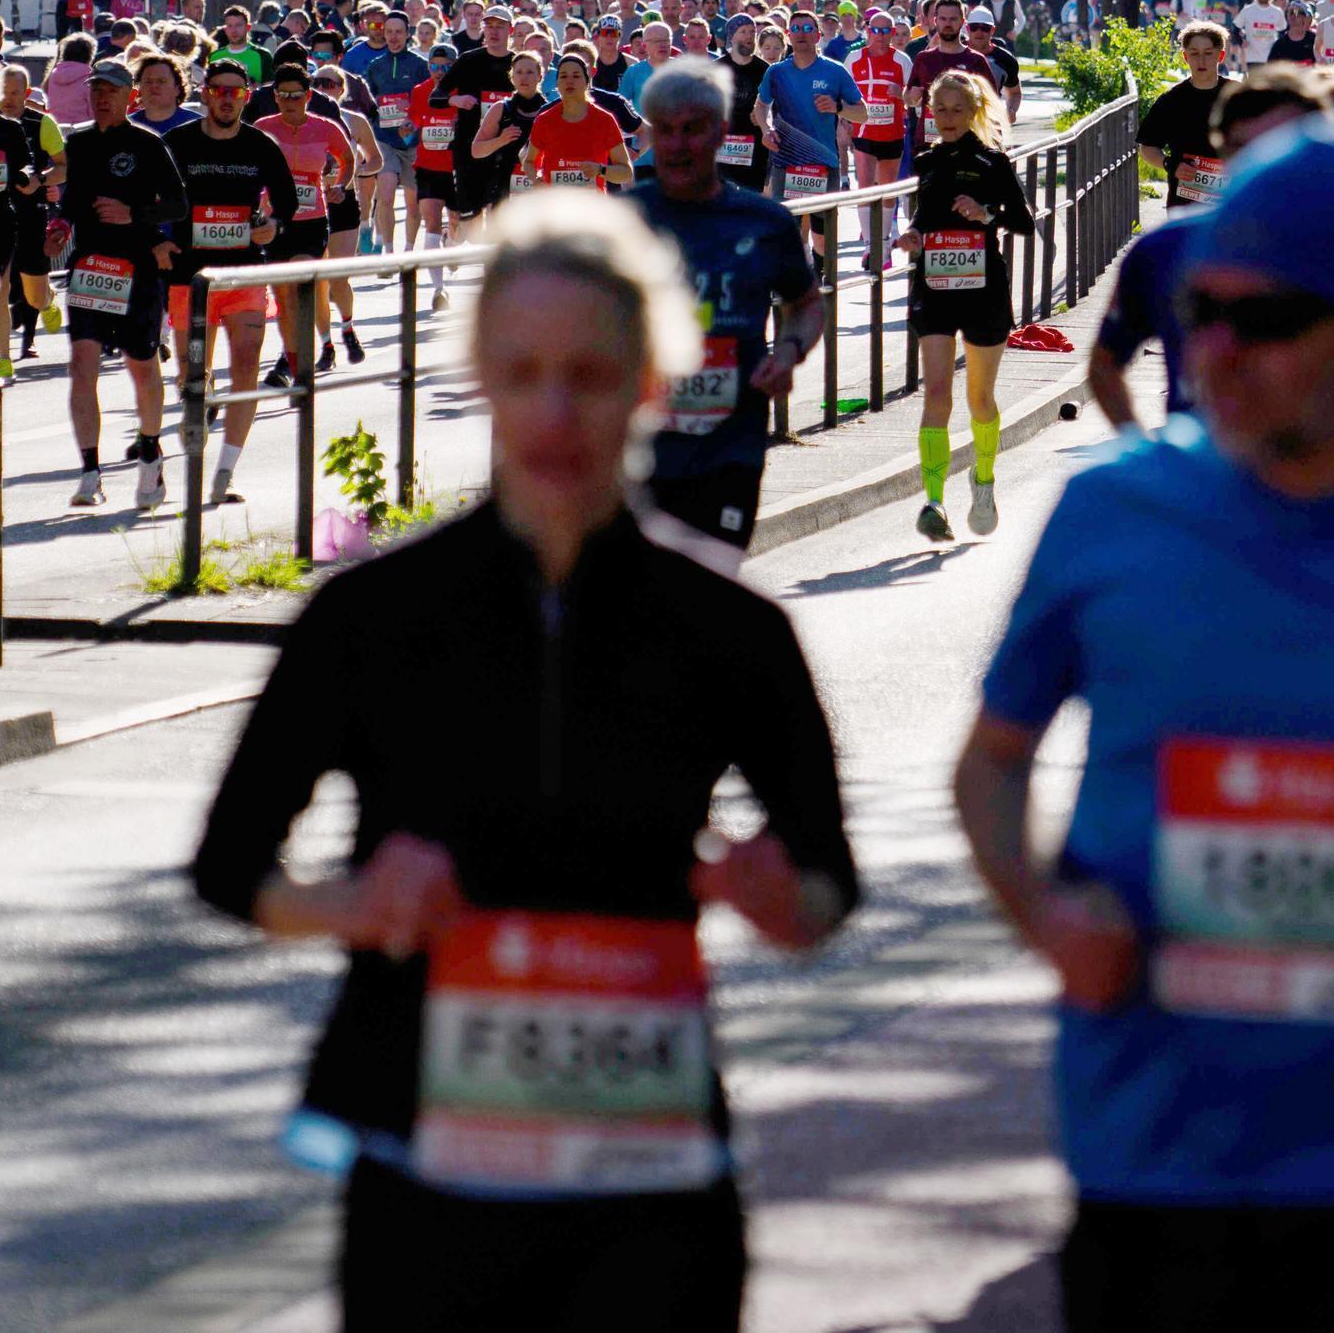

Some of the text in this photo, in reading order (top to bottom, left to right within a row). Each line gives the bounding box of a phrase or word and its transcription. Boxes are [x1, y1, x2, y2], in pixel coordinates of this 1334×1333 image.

[215, 210, 239, 220] Haspa
[945, 233, 971, 246] Haspa
[95, 259, 121, 272] Haspa
